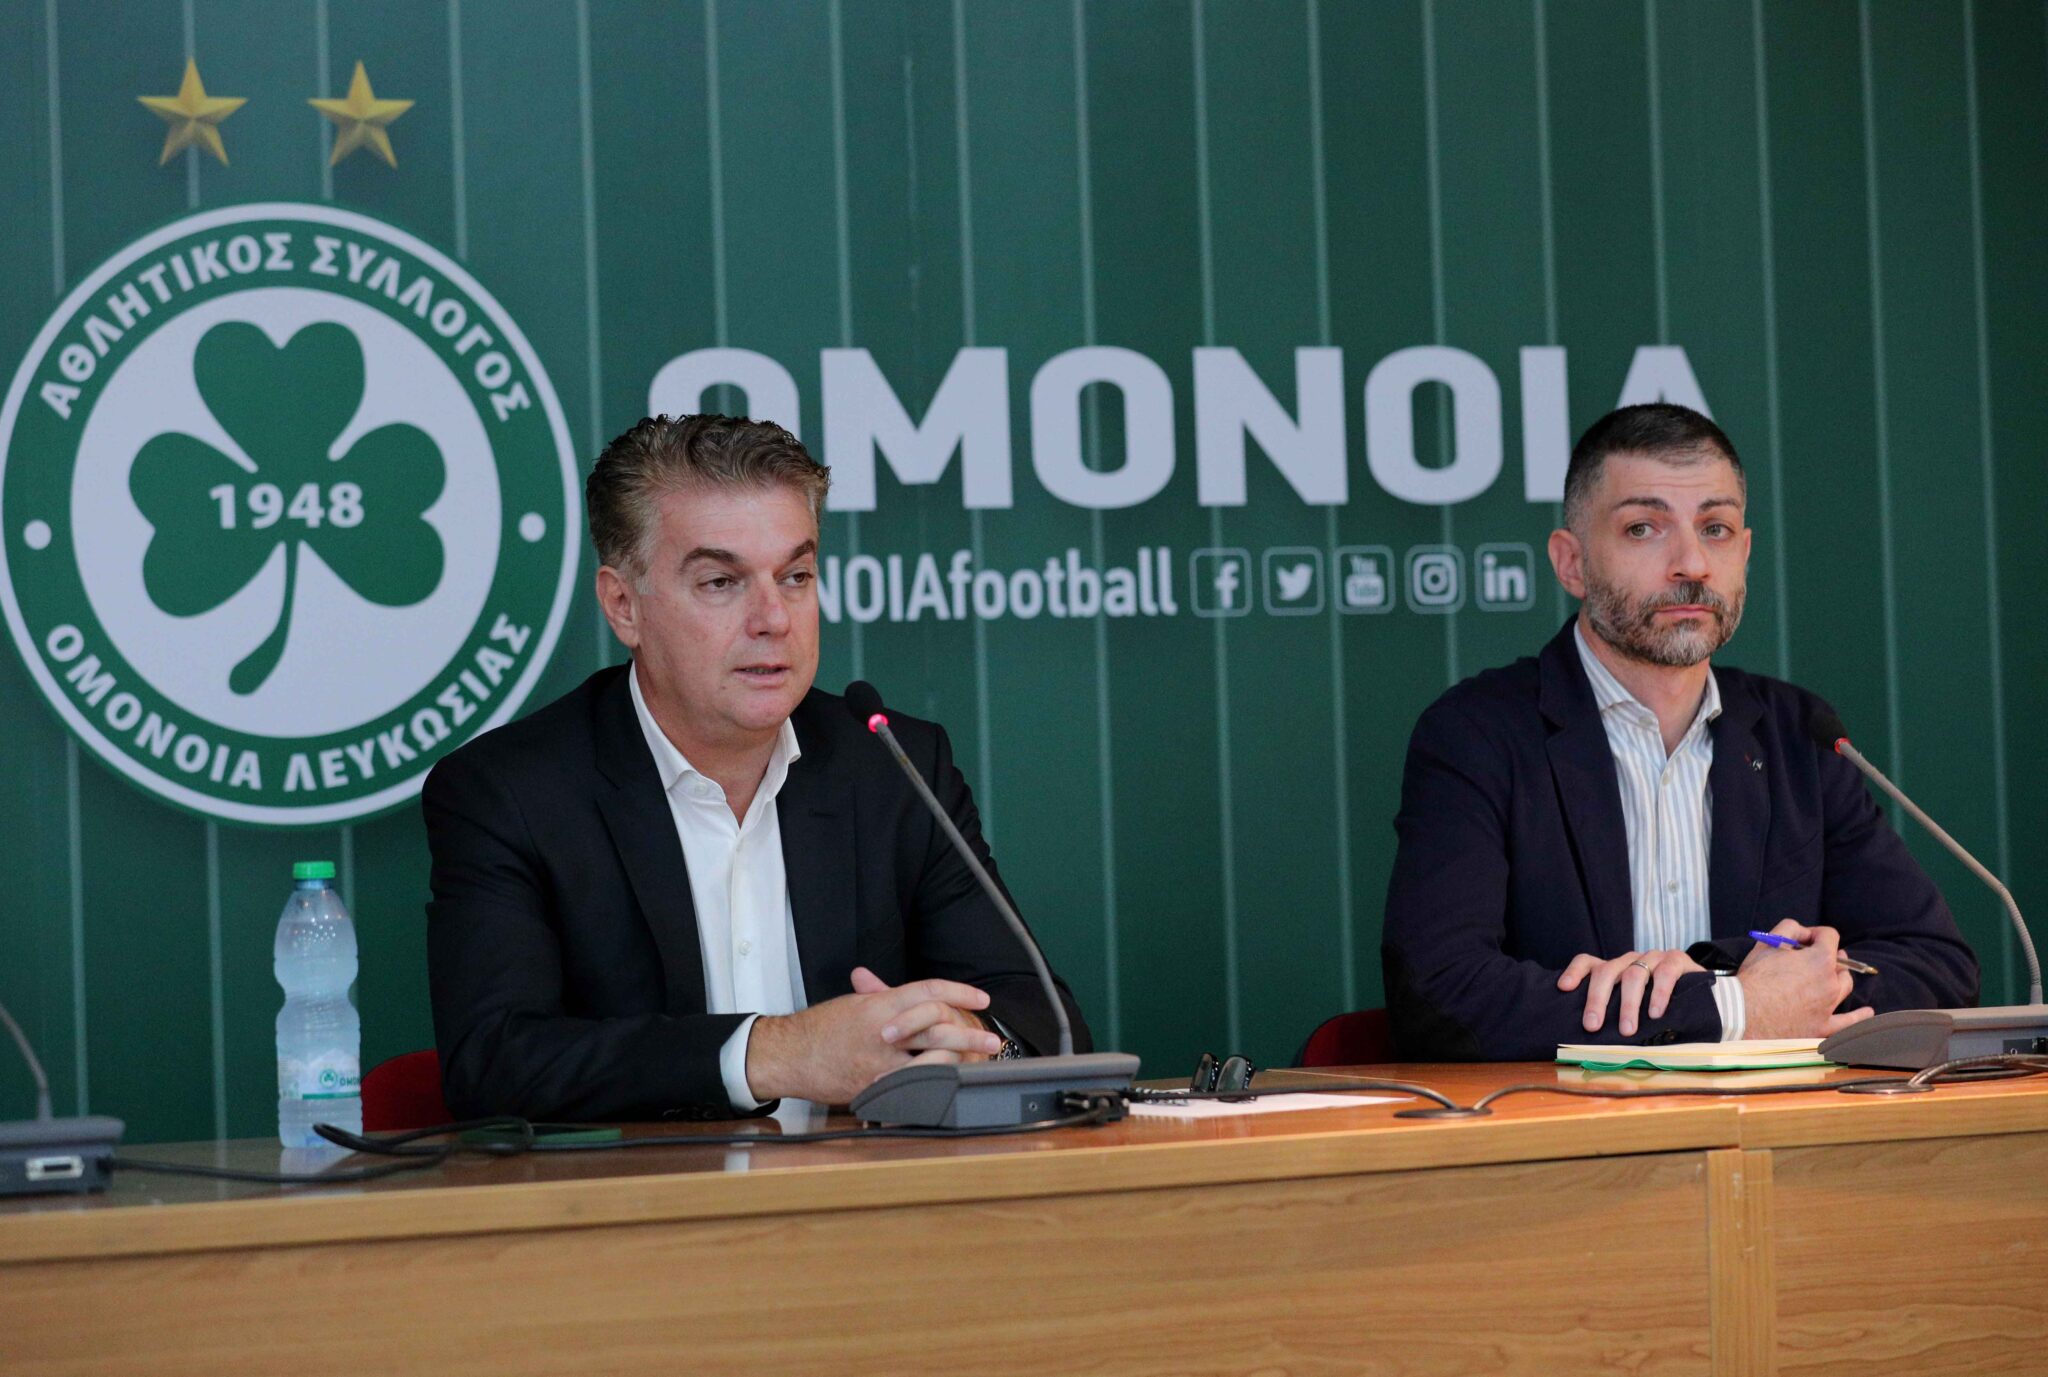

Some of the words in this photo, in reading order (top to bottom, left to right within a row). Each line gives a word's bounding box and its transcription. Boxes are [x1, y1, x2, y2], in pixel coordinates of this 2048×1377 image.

[40, 232, 294, 420] ΑΘΛΗΤΙΚΟΣ
[309, 235, 531, 422] ΣΥΛΛΟΓΟΣ
[209, 483, 365, 529] 1948
[46, 624, 262, 790] ΟΜΟΝΟΙΑ
[284, 613, 531, 792] ΛΕΥΚΩΣΙΑΣ
